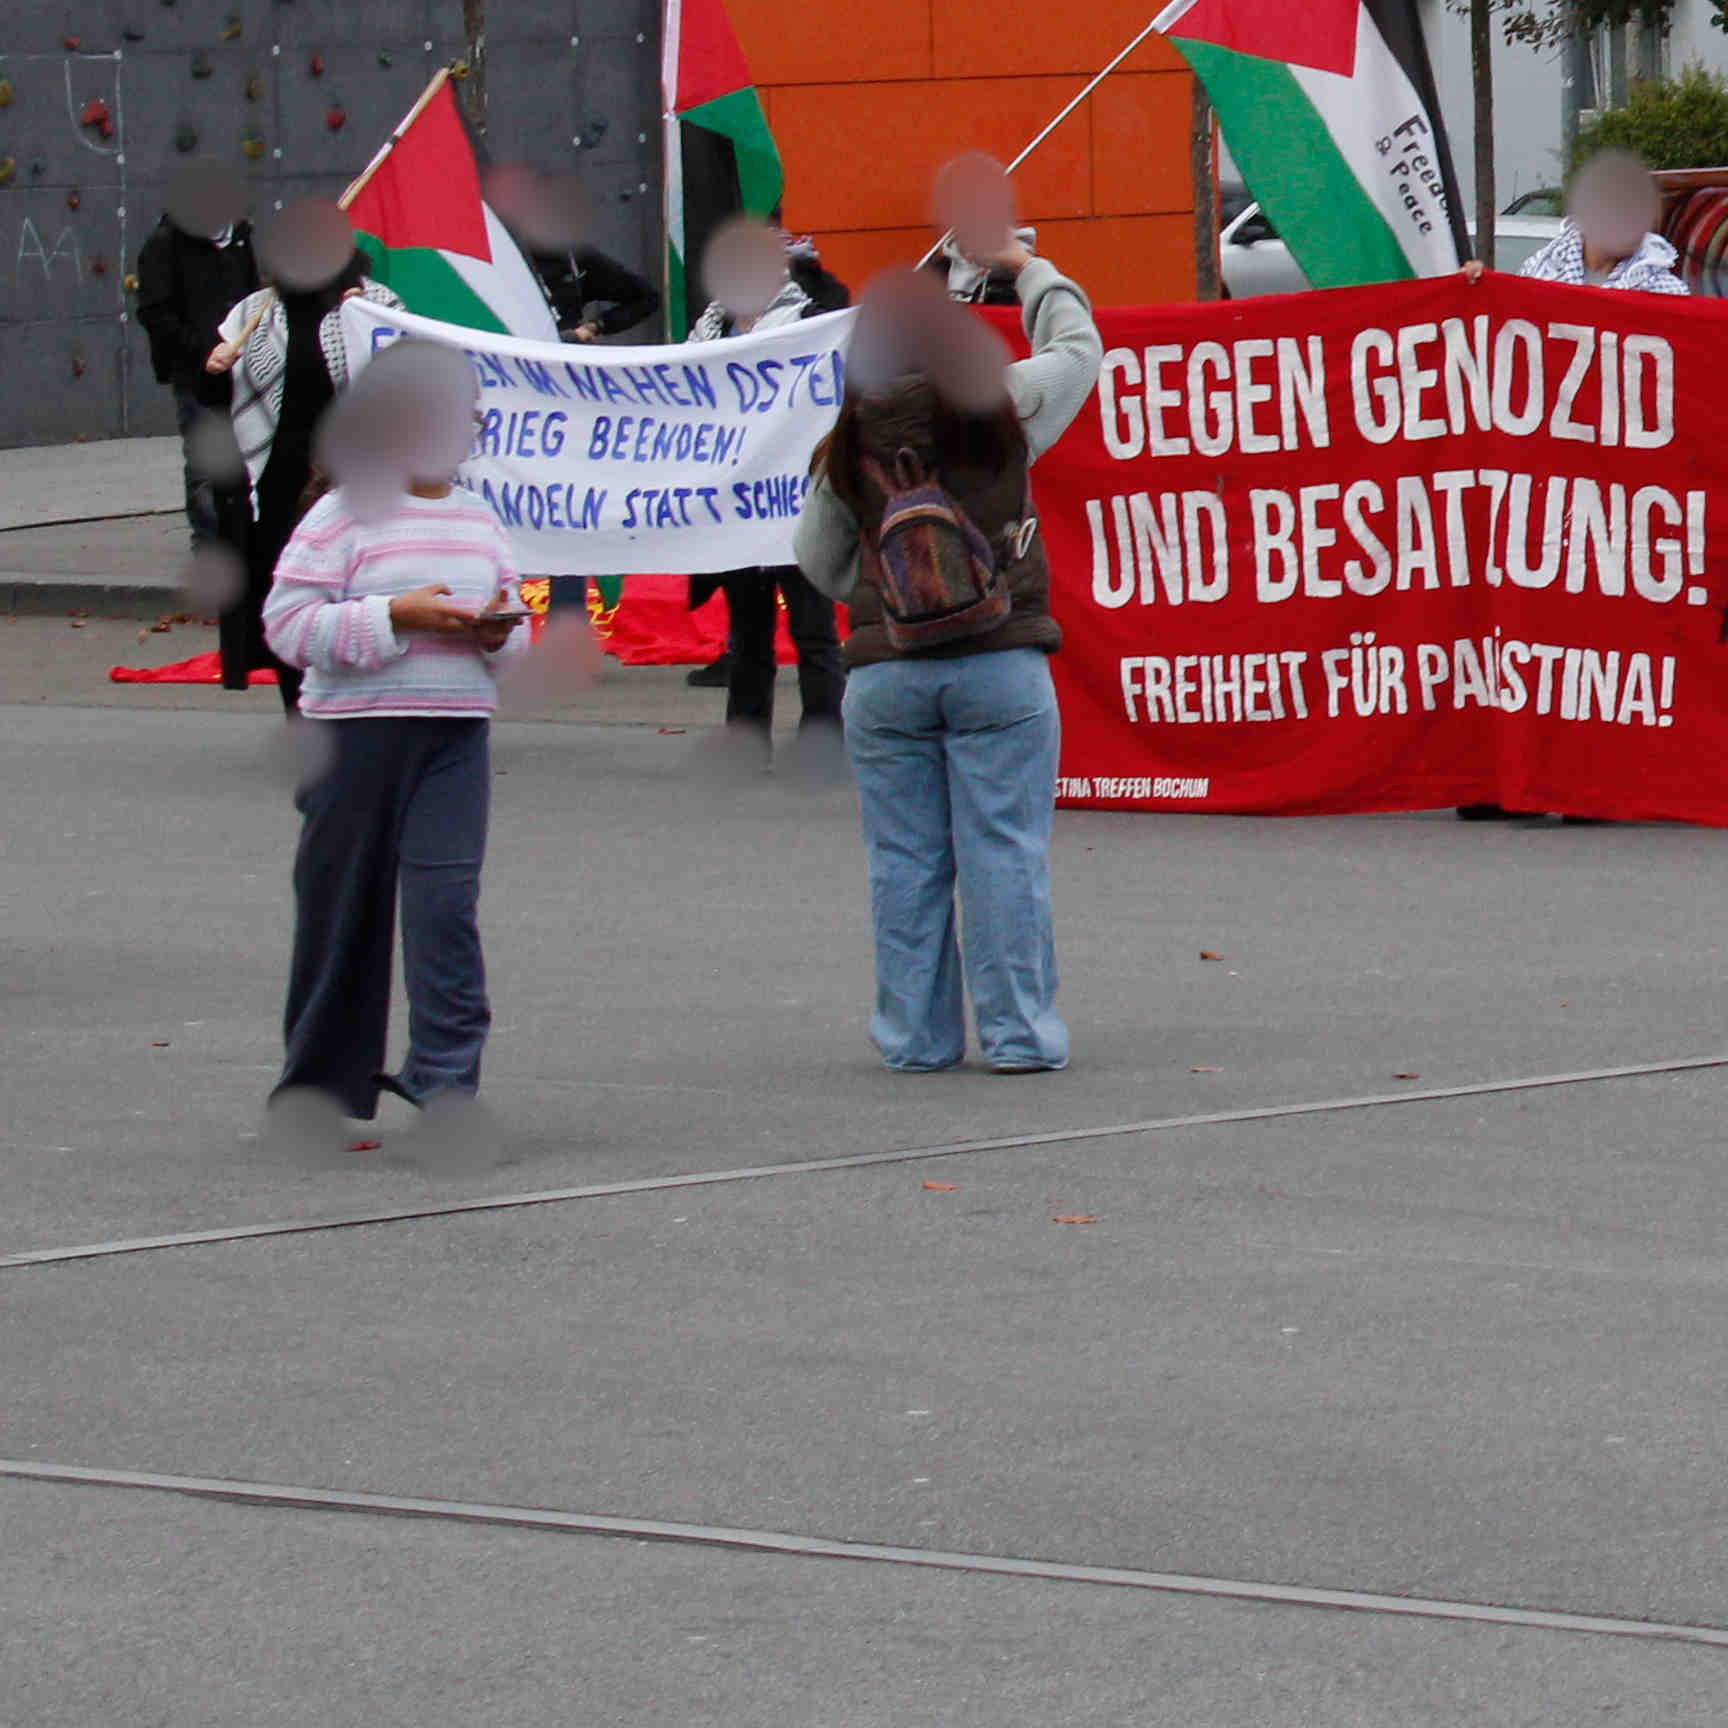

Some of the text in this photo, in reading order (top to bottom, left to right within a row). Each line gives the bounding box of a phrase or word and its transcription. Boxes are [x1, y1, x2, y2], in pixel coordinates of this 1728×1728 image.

[1390, 160, 1433, 236] Peace
[564, 361, 717, 410] NAHEN
[1099, 315, 1675, 460] GEGEN GENOZID
[480, 408, 747, 466] RIEG BEENDEN!
[621, 486, 723, 529] STATT
[1085, 490, 1229, 609] UND
[1120, 650, 1309, 724] FREIHEIT
[1321, 631, 1408, 718] FÜR
[1092, 777, 1151, 799] TREFFEN
[1152, 777, 1210, 799] BOCHUM
